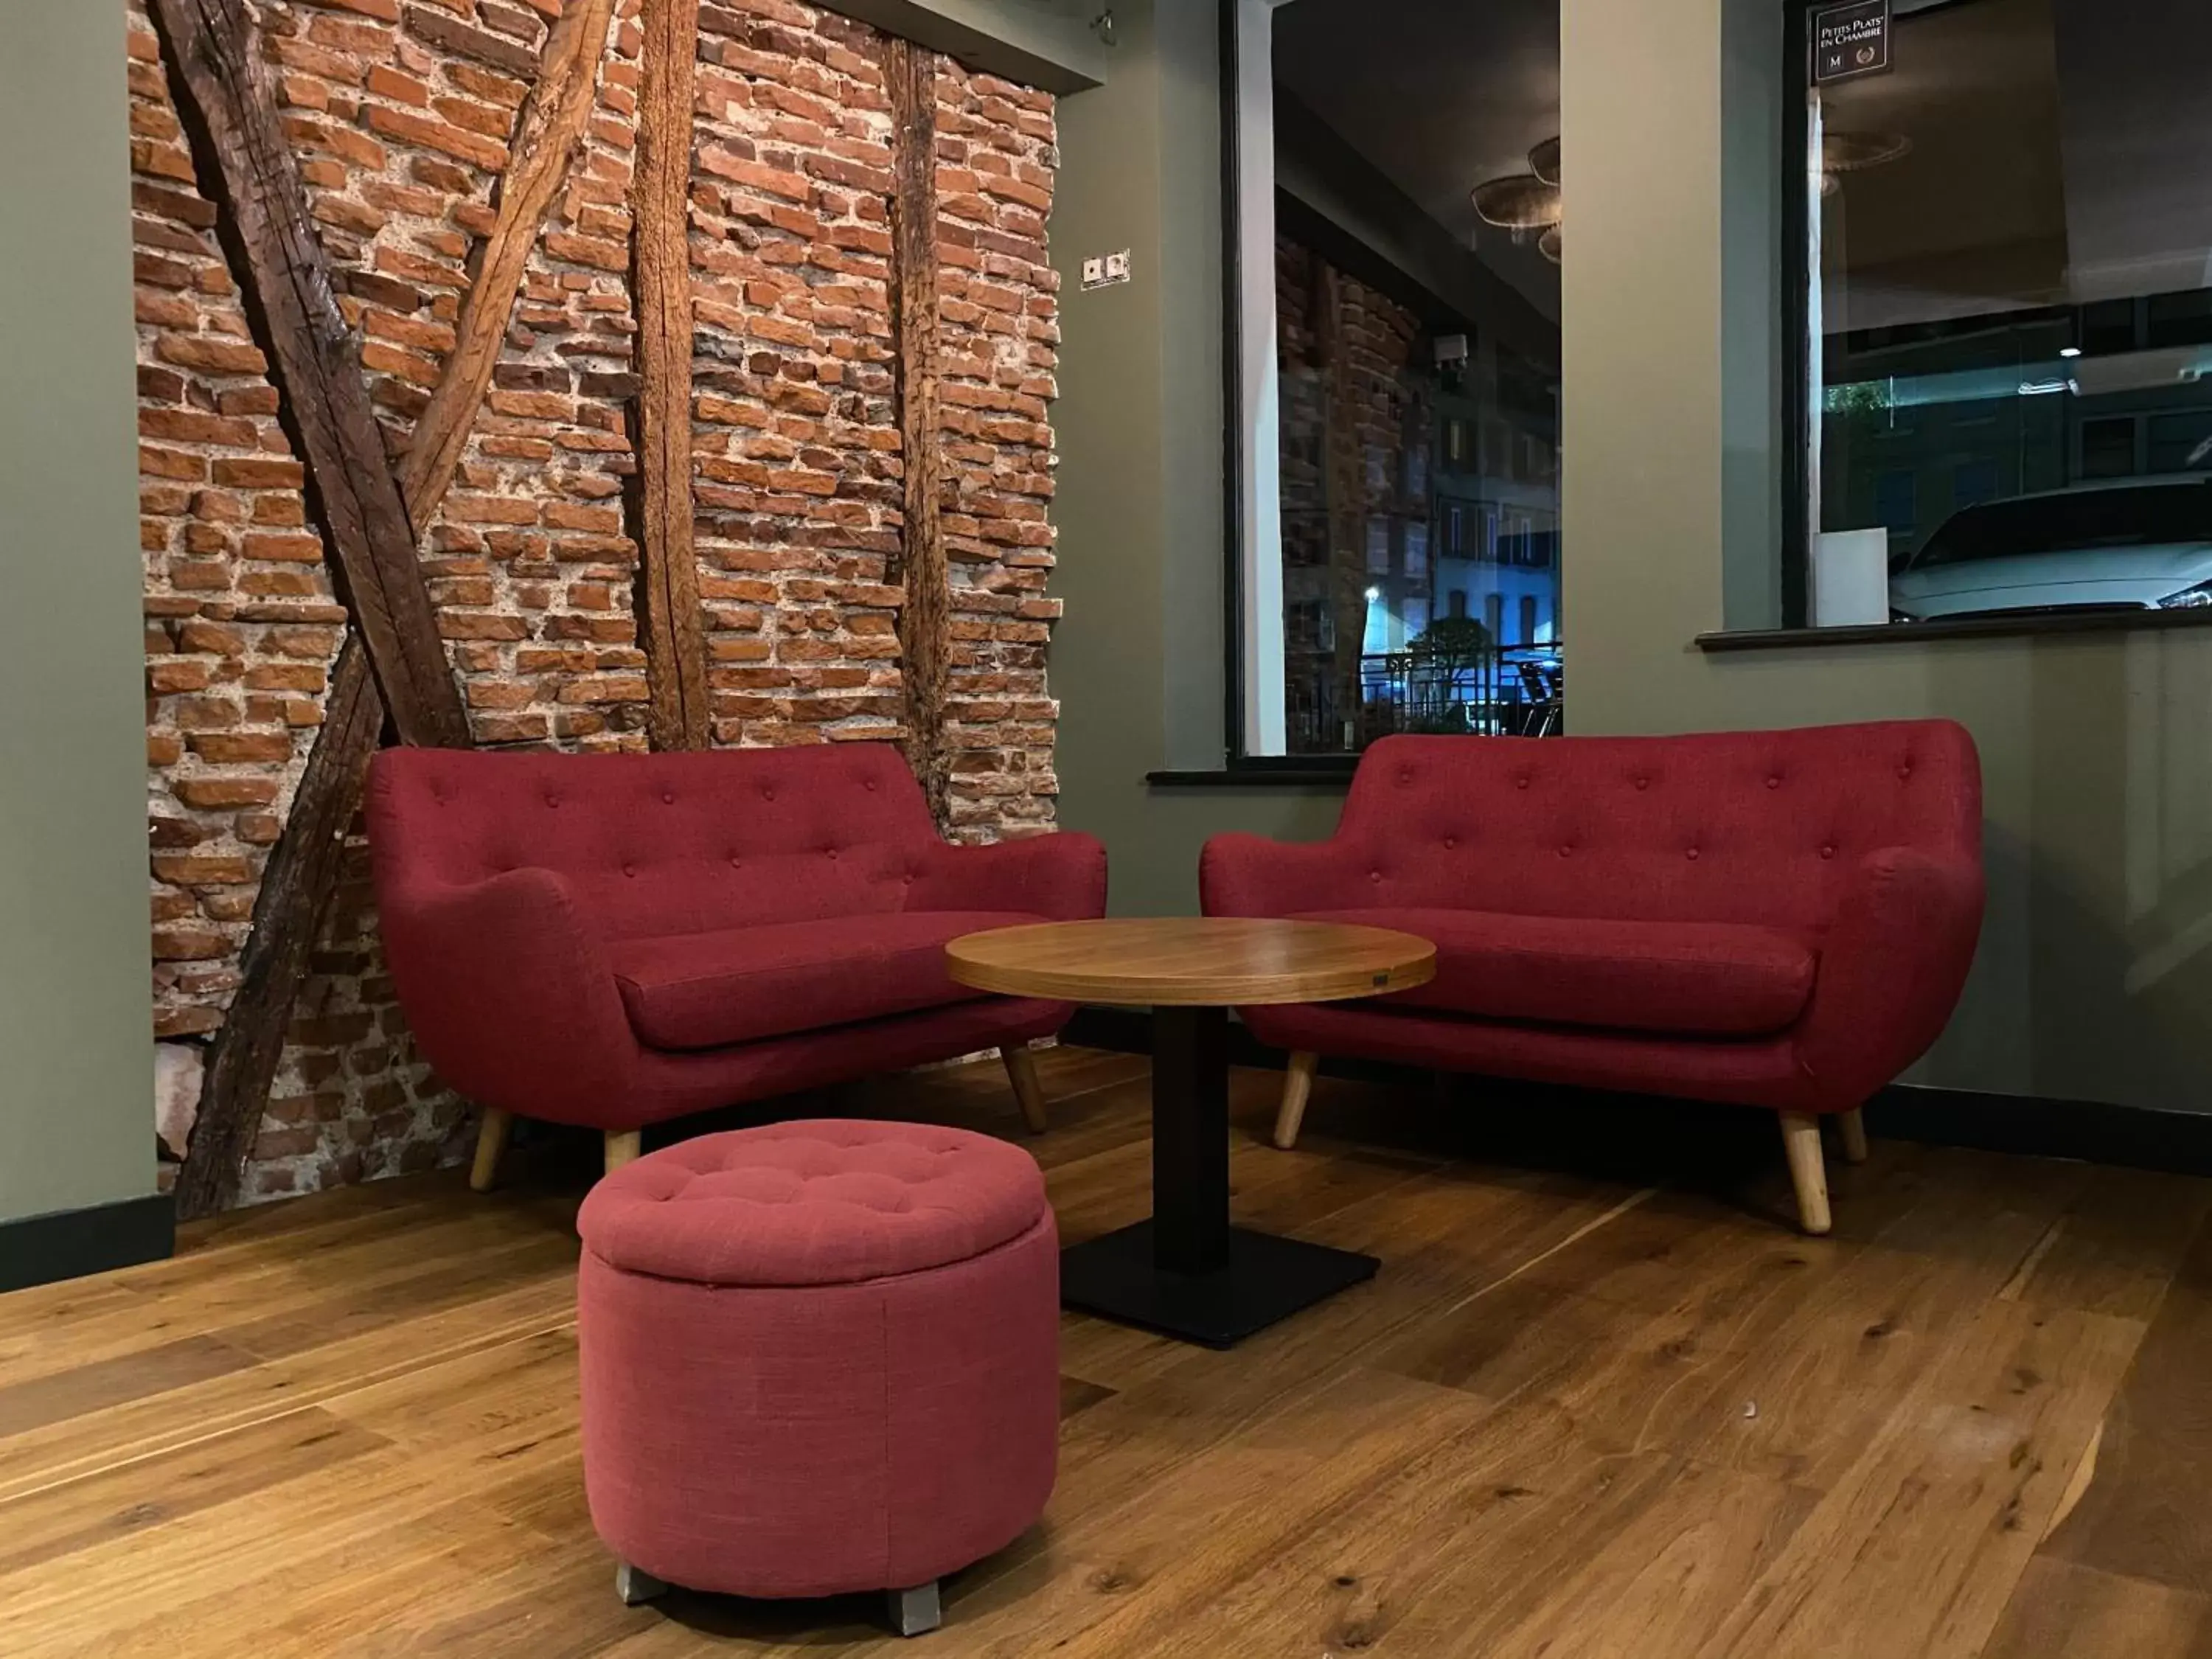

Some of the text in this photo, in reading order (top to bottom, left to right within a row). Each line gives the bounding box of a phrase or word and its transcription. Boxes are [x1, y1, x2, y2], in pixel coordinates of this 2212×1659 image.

[1820, 27, 1882, 48] EN CHAMBRE
[1822, 24, 1851, 38] PETITS
[1830, 56, 1841, 69] M
